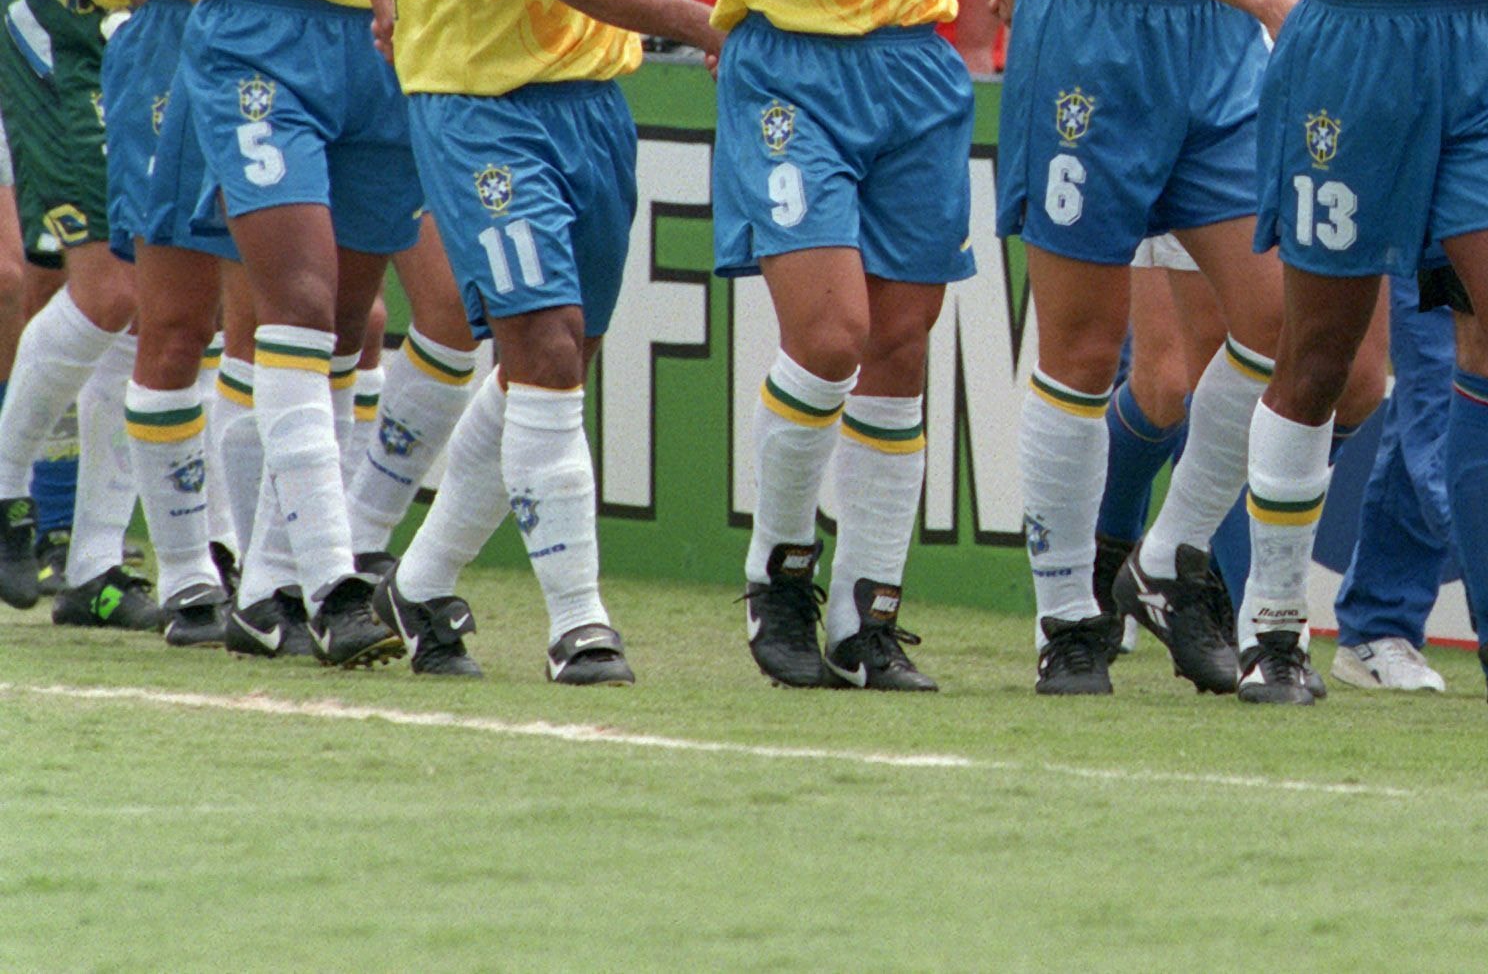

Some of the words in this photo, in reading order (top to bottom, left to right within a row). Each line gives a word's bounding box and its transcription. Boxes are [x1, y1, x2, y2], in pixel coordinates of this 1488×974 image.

[236, 121, 286, 187] 5
[1043, 153, 1087, 226] 6
[767, 162, 808, 227] 9
[1293, 175, 1358, 251] 13
[478, 218, 545, 295] 11
